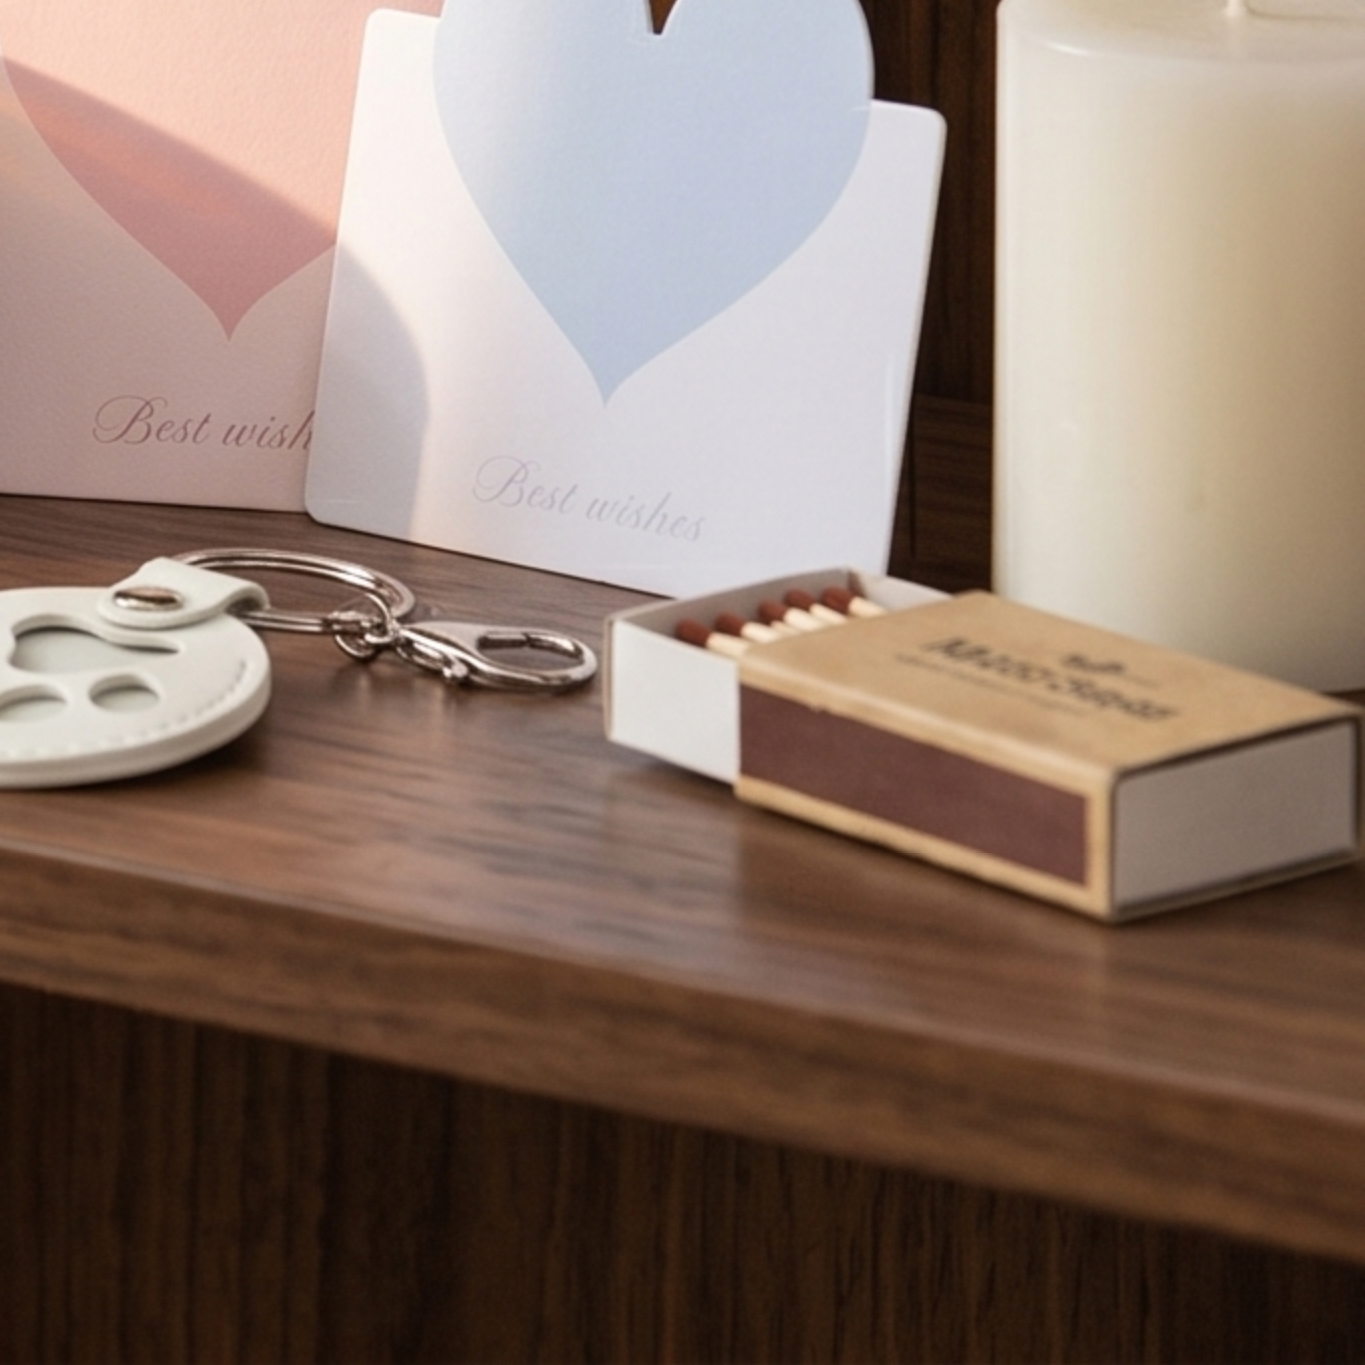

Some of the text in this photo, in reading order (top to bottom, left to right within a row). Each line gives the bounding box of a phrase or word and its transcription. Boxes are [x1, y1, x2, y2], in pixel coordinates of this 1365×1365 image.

[92, 394, 212, 446] Best
[472, 454, 707, 543] Best wishes
